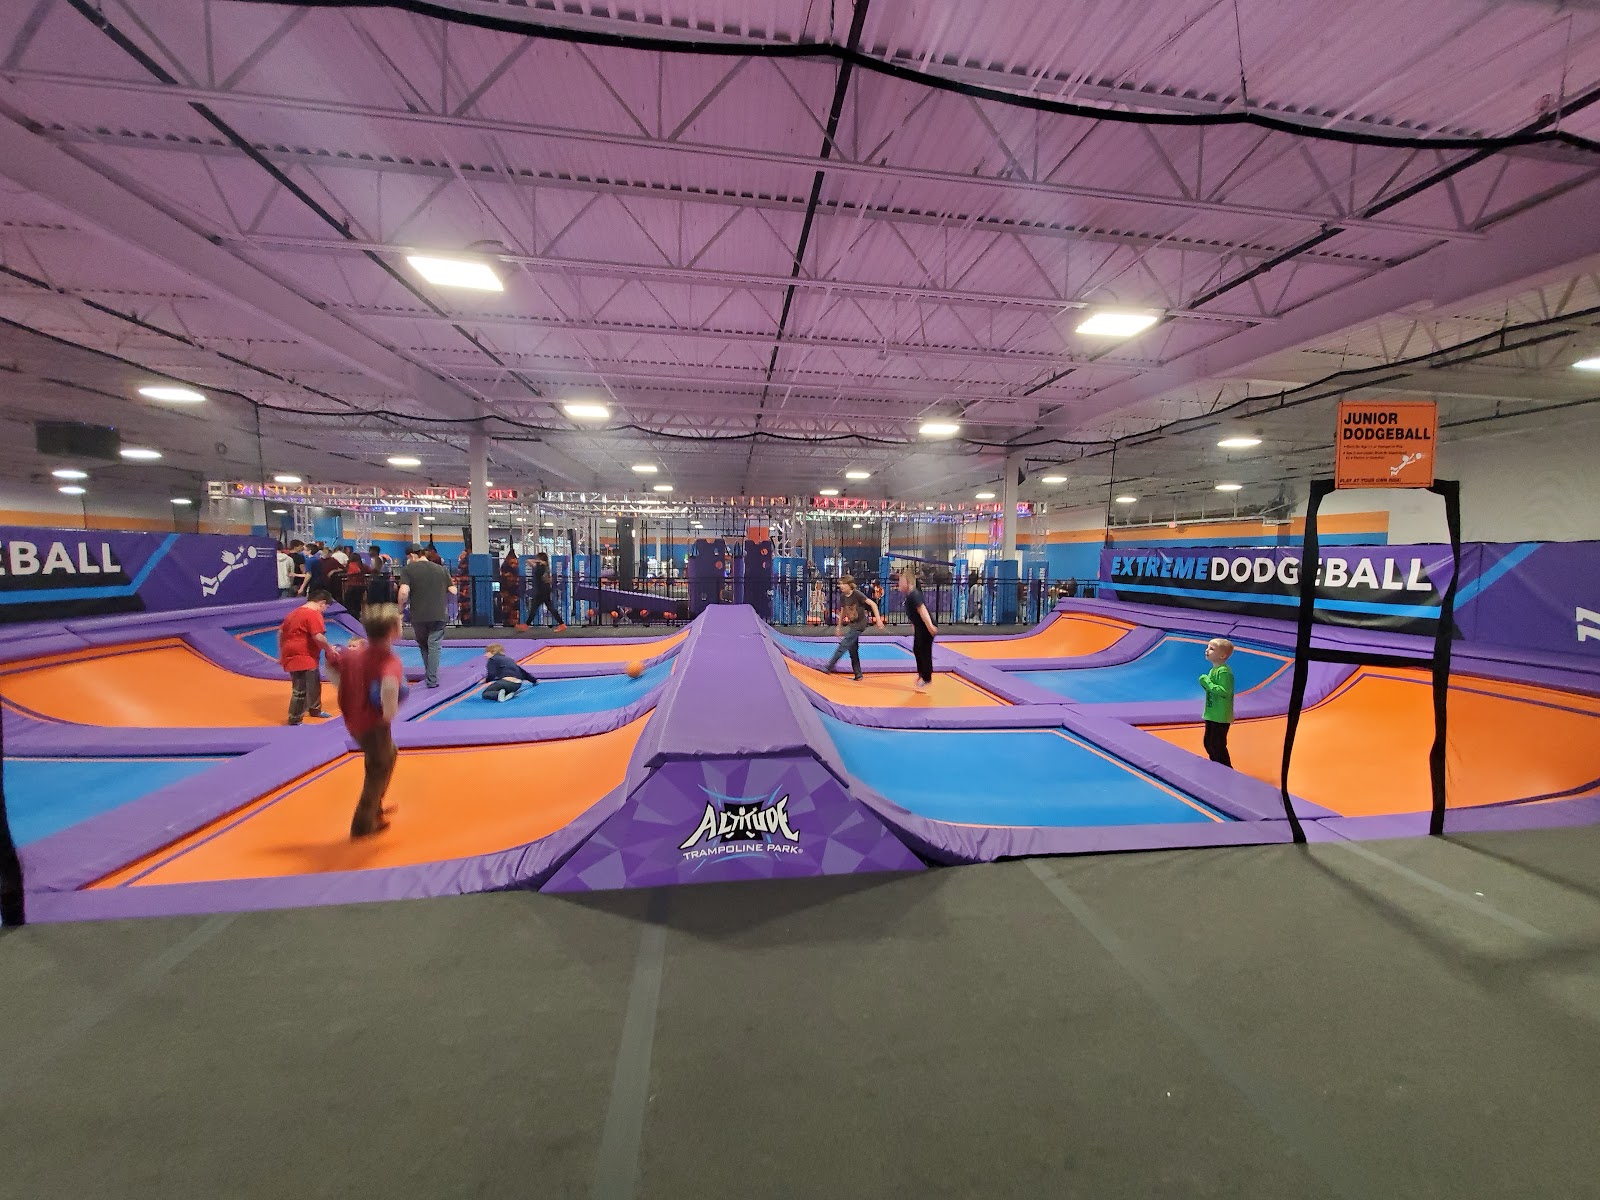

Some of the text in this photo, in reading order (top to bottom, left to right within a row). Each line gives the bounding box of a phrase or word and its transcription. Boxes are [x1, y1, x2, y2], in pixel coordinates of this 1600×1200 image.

[1343, 412, 1398, 425] JUNIOR
[1343, 427, 1431, 440] DODGEBALL
[0, 541, 121, 576] BALL
[1110, 556, 1210, 581] EXTREME
[682, 843, 764, 861] TRAMPOLINE
